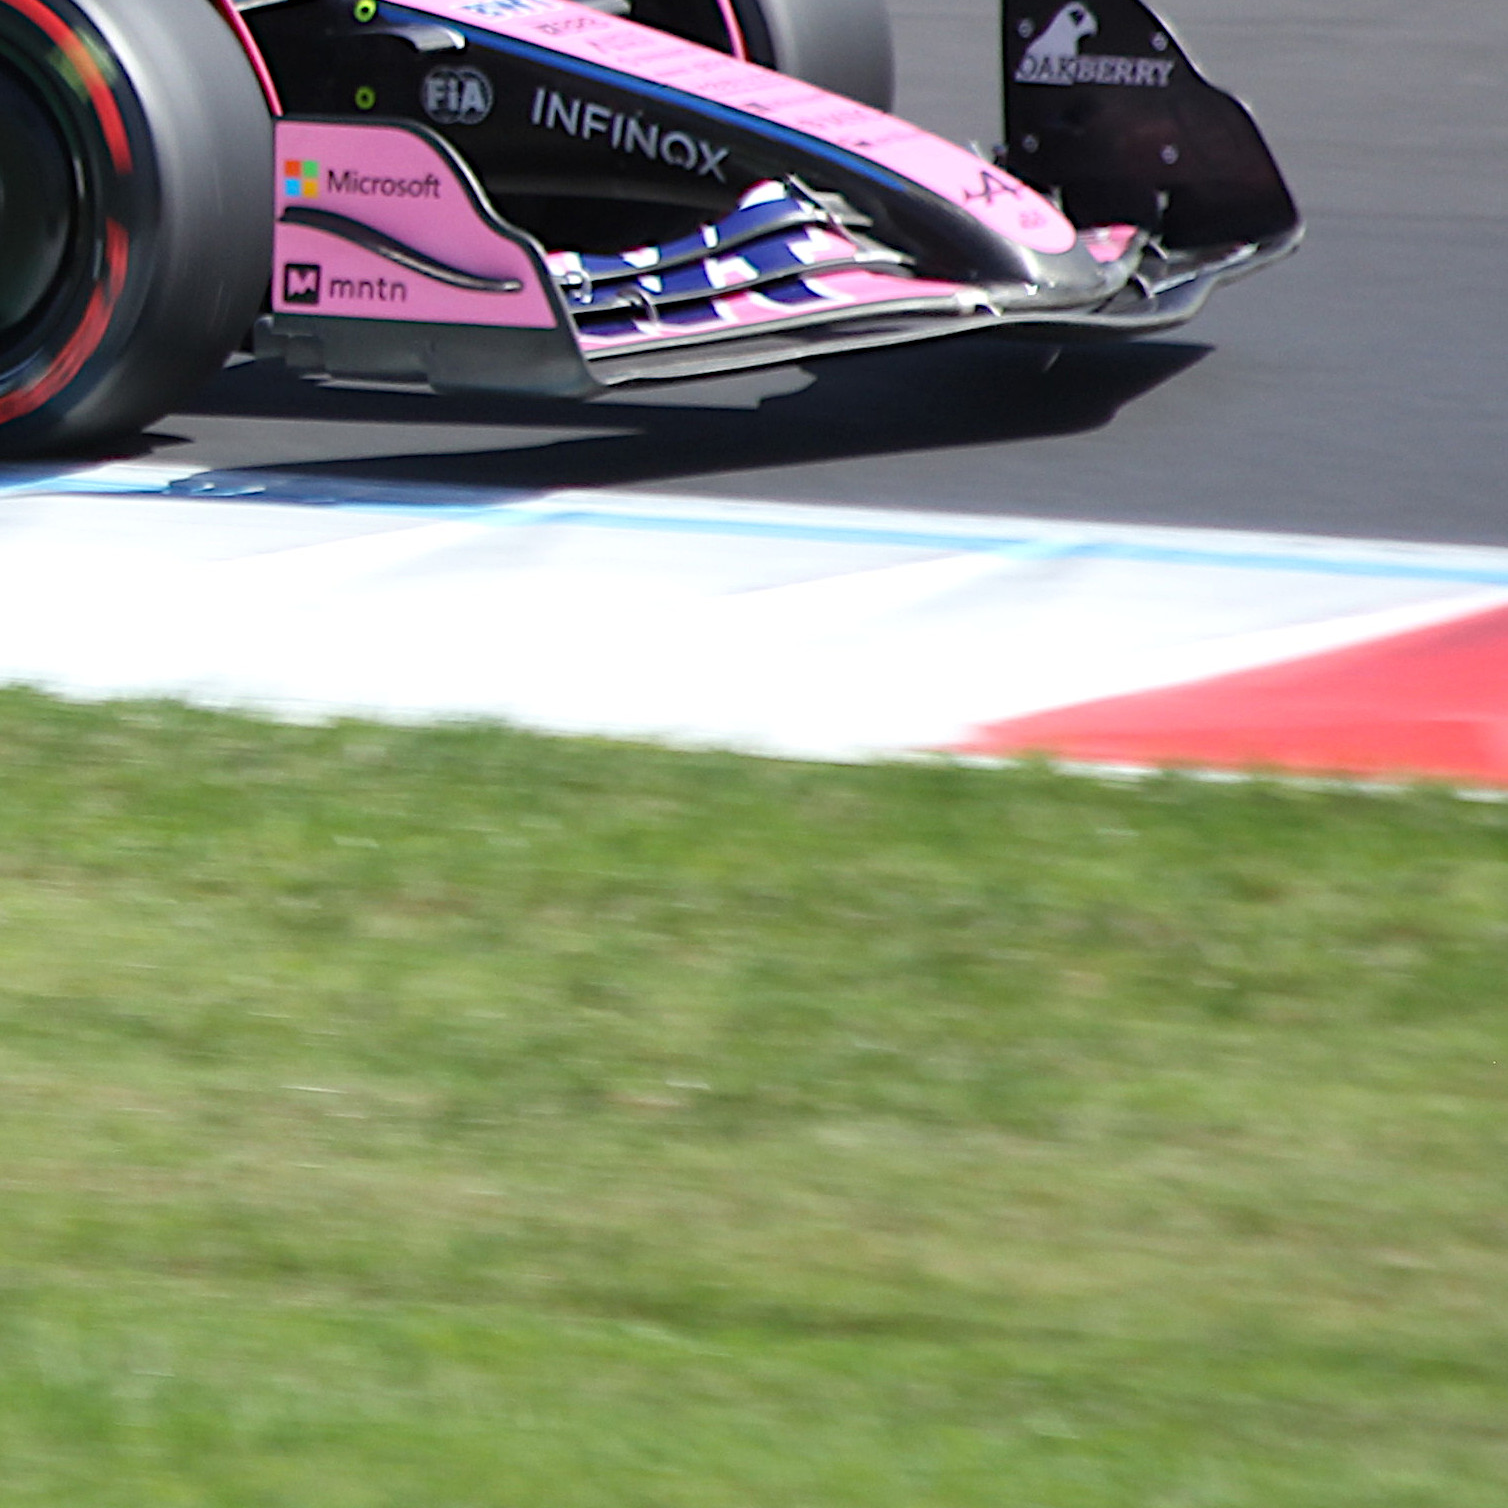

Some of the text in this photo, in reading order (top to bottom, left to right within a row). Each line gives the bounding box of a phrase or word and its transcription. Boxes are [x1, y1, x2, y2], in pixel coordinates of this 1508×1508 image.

[1019, 55, 1175, 88] OAKBERRY
[426, 77, 486, 112] FIA
[531, 86, 730, 181] INFINOX
[327, 170, 441, 198] Microsoft
[329, 278, 407, 301] mntn
